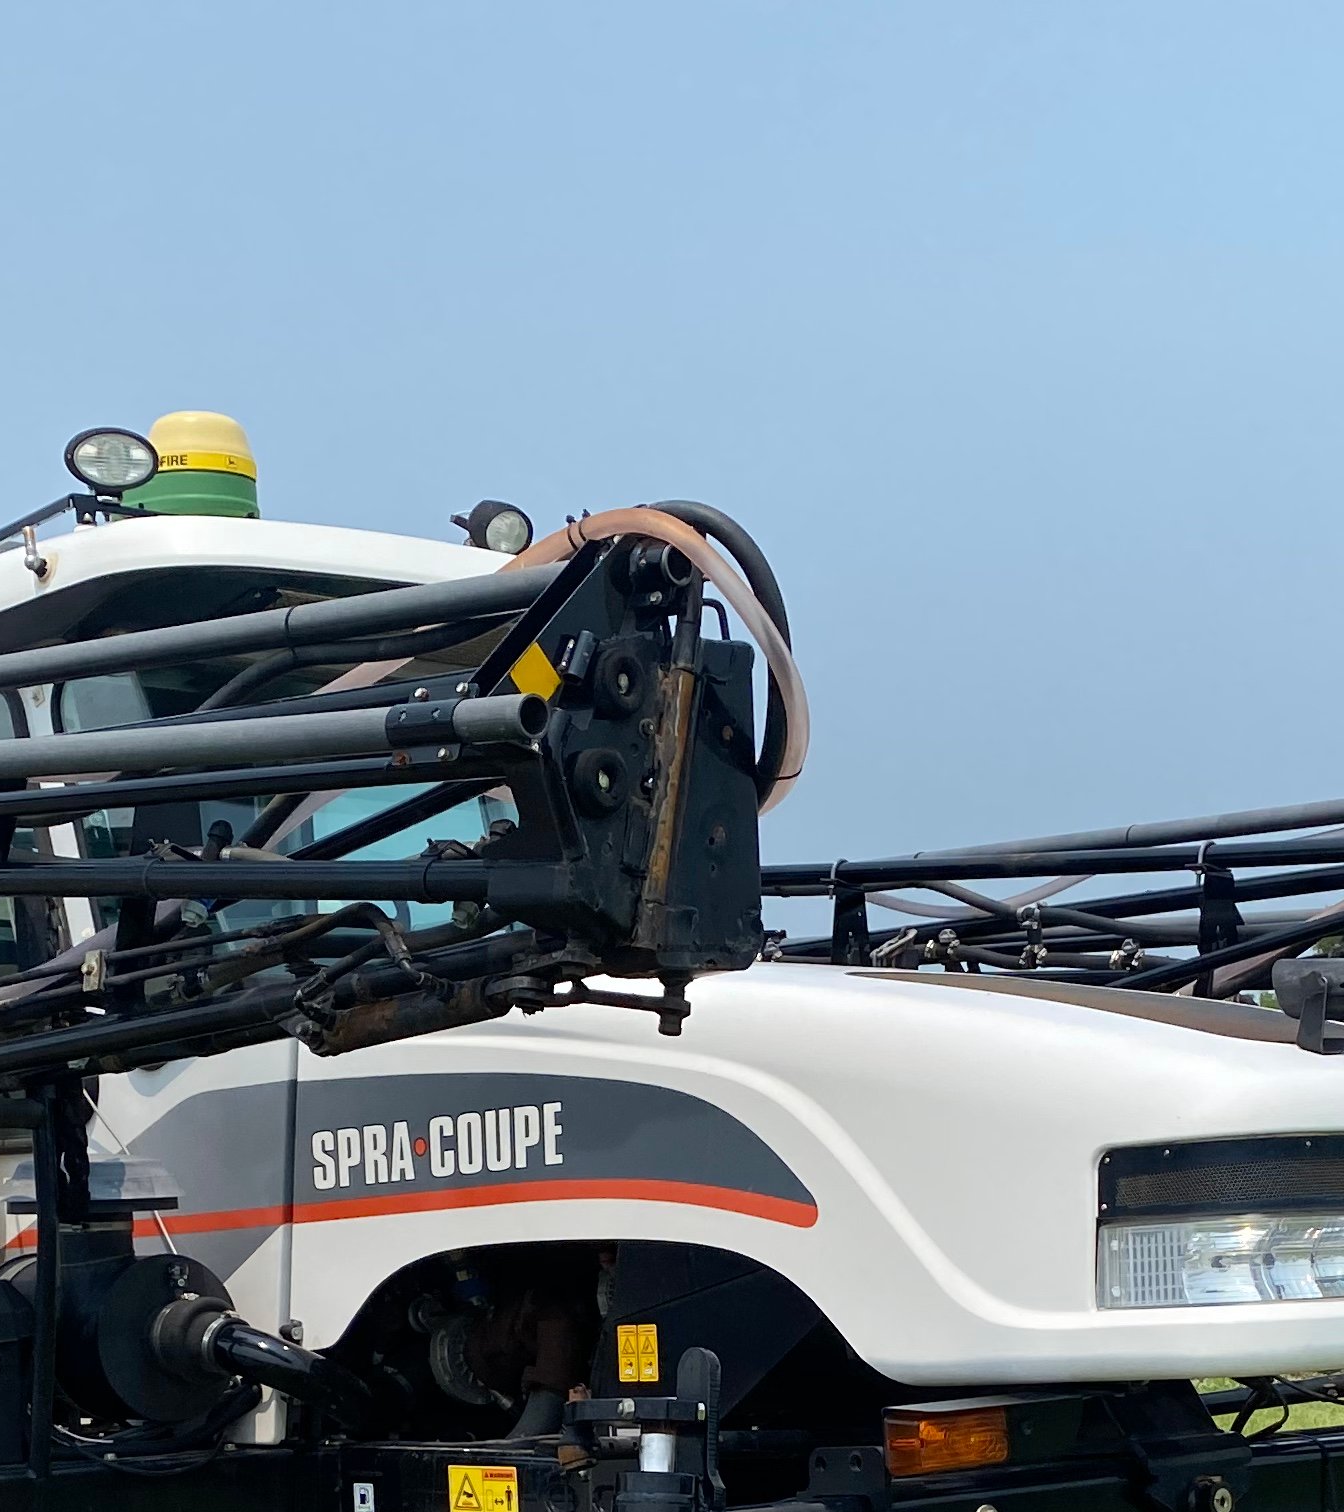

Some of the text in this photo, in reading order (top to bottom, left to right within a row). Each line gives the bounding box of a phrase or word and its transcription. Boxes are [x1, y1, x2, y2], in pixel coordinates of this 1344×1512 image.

[159, 453, 188, 467] FIRE
[311, 1101, 564, 1191] SPRA COUPE
